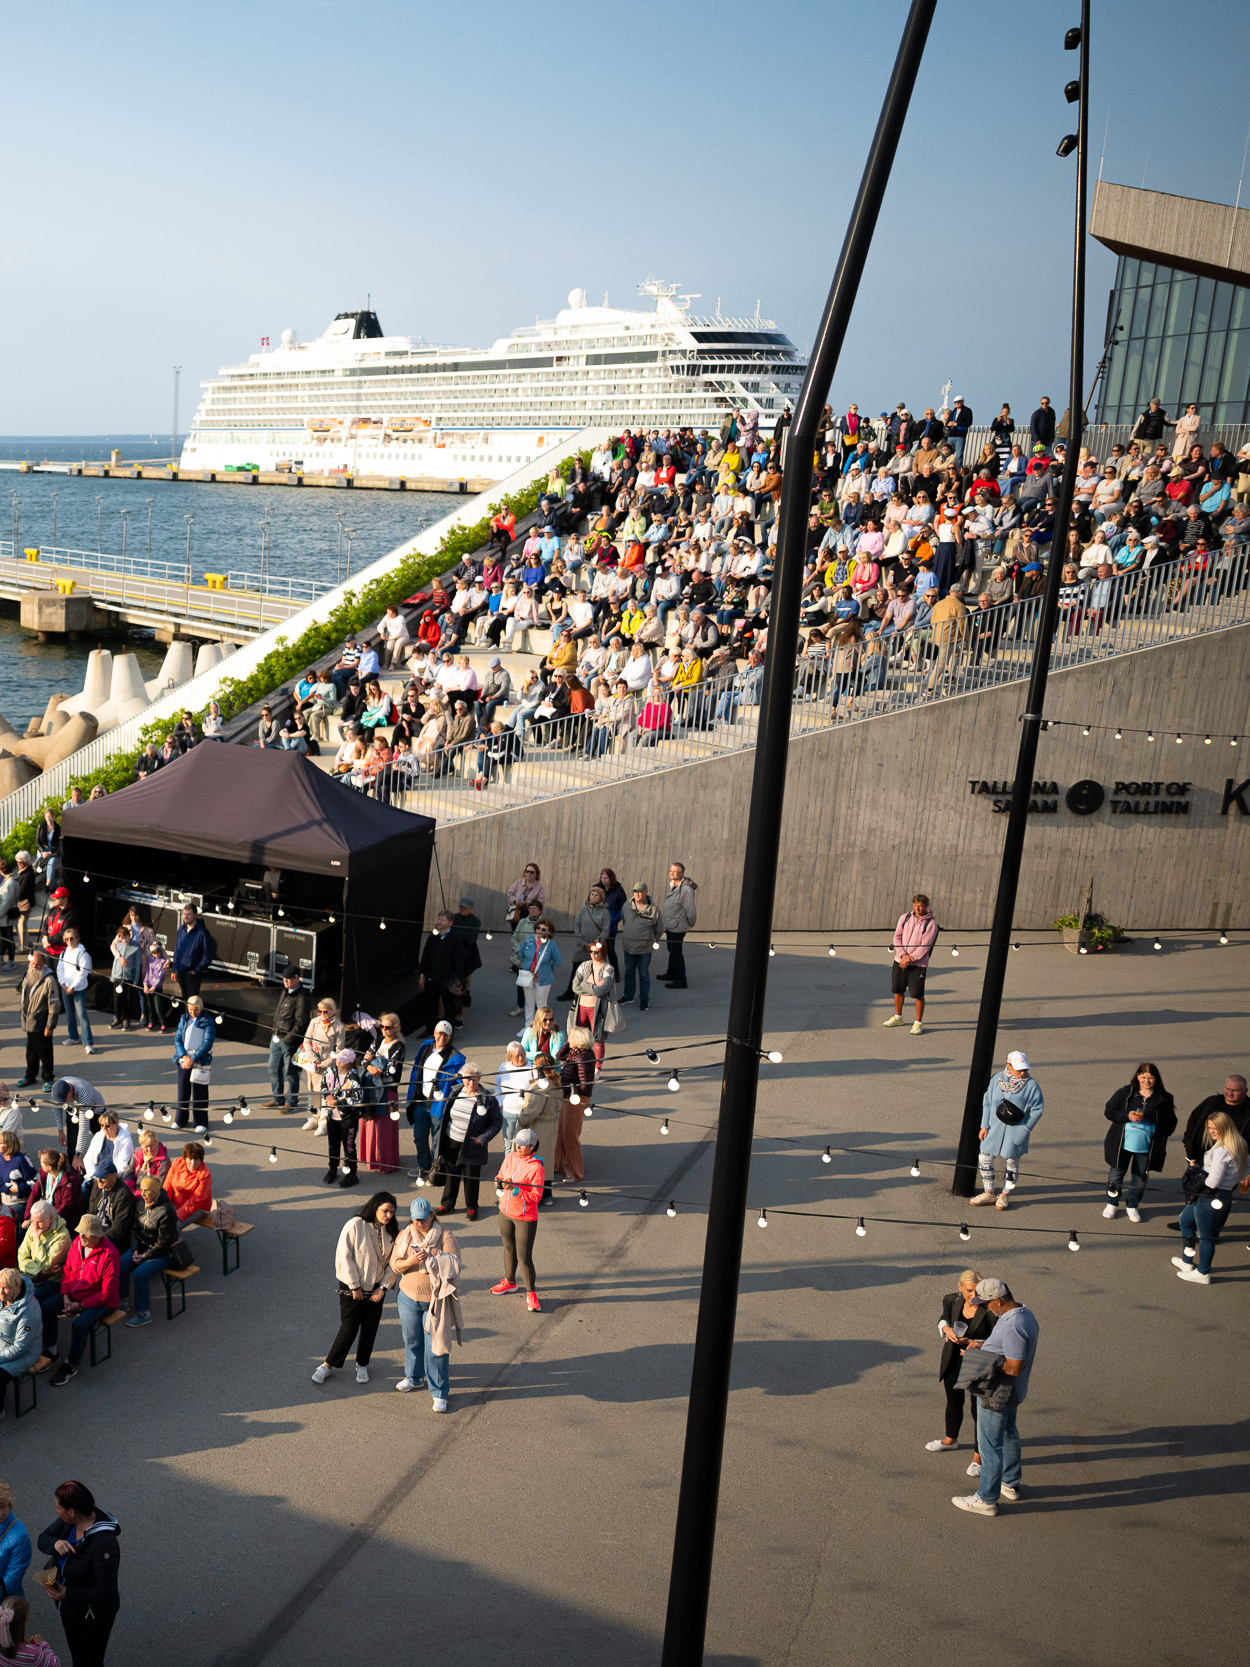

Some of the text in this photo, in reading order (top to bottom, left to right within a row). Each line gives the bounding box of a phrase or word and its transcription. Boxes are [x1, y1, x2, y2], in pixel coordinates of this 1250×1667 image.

[968, 780, 1060, 795] TALLNA
[1114, 781, 1192, 796] PORT OF
[992, 799, 1058, 814] SAAM
[1110, 800, 1190, 815] TALLINN
